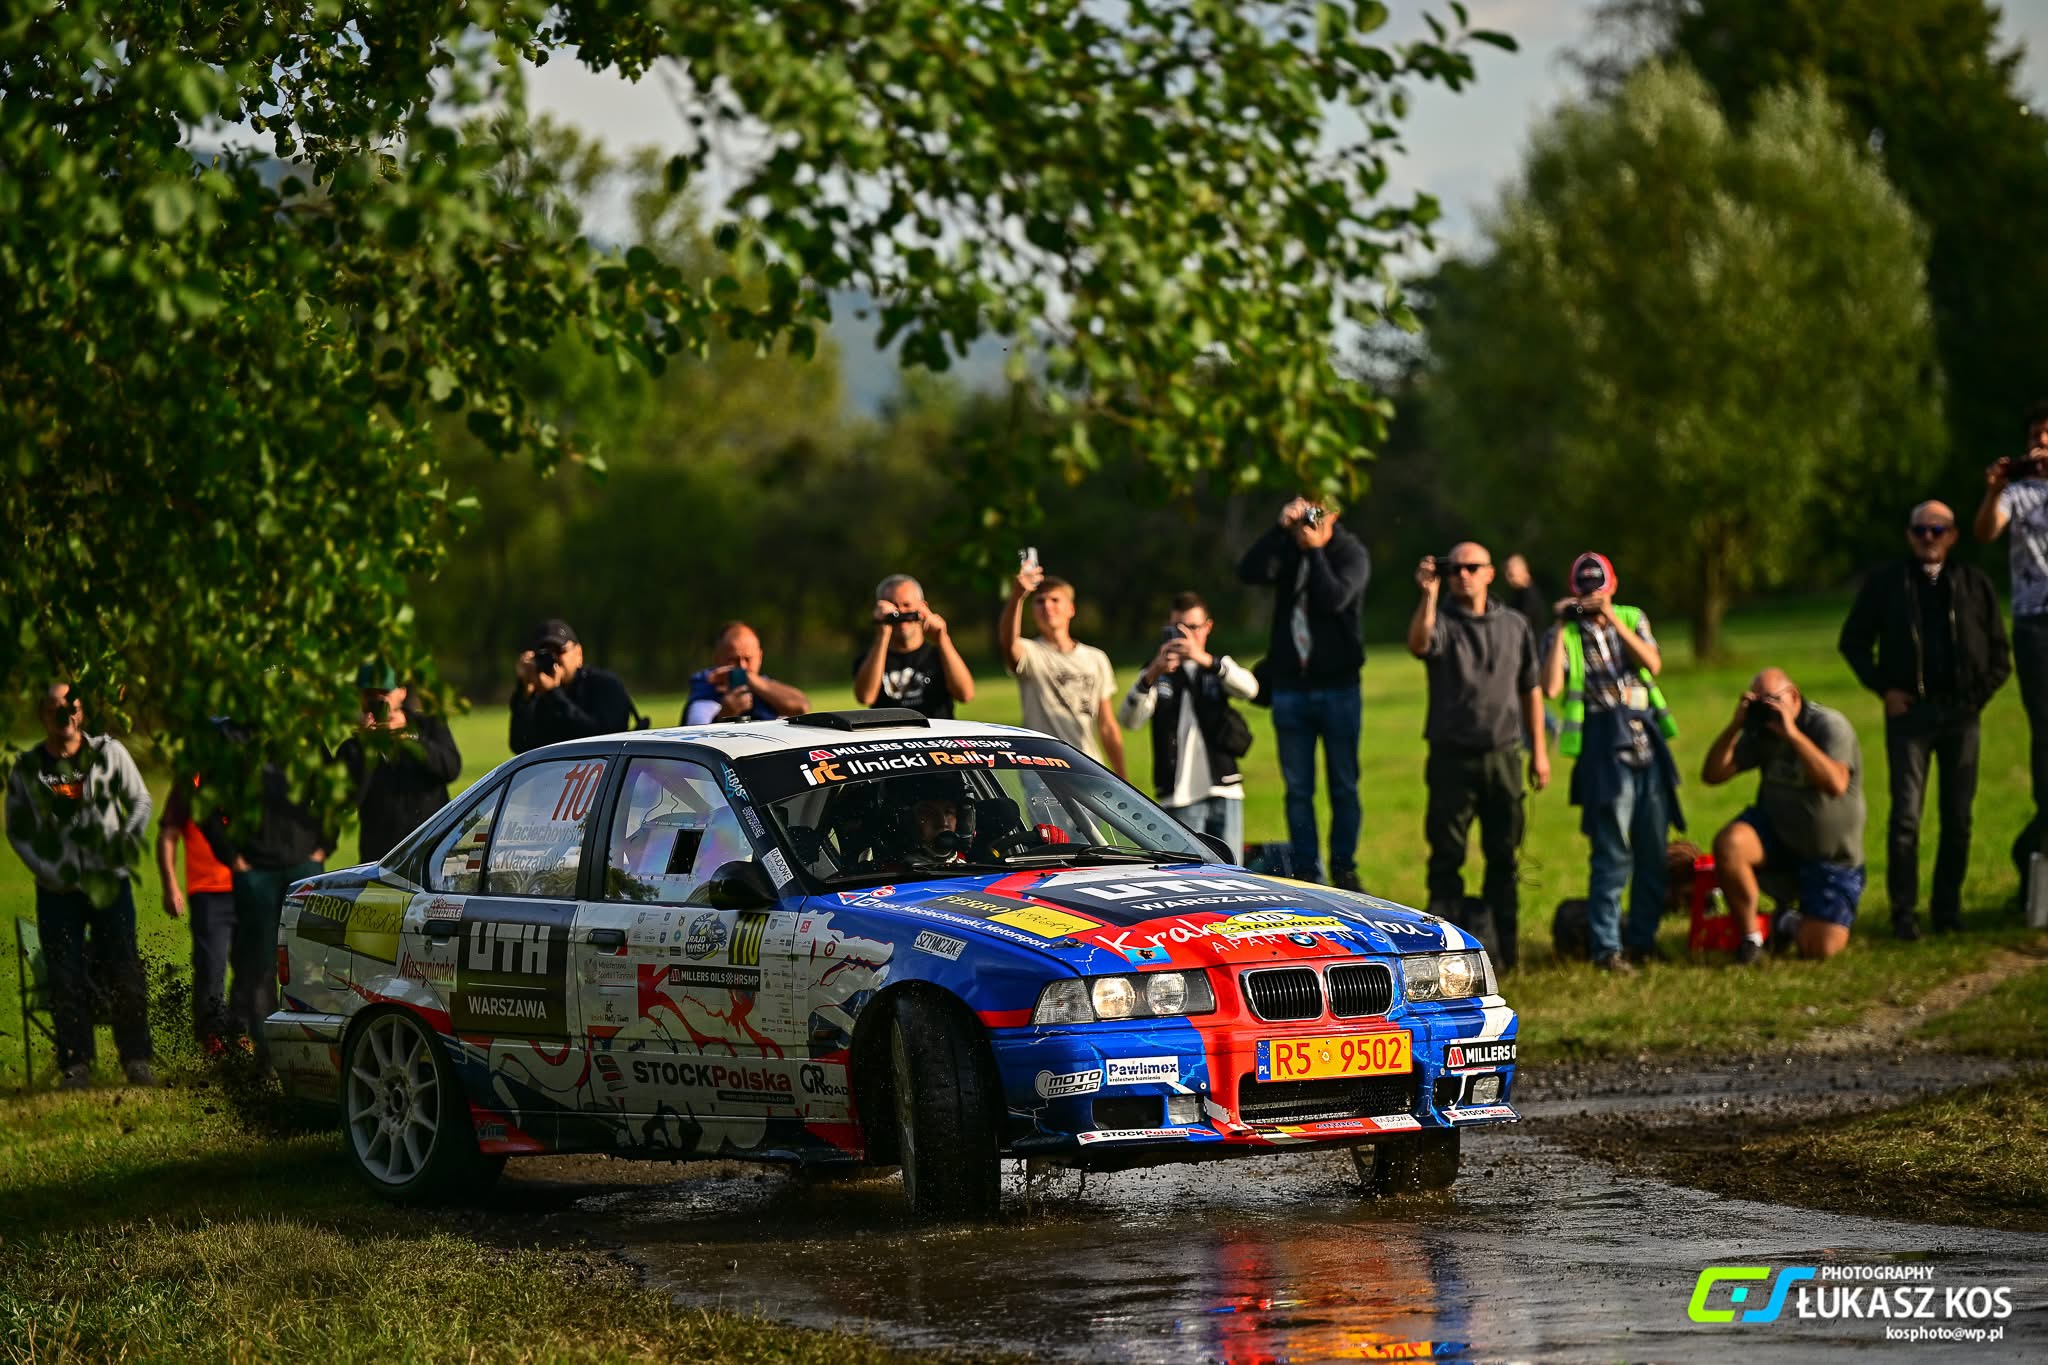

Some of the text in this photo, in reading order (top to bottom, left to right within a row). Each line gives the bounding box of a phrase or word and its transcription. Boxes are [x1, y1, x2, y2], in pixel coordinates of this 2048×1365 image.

[832, 739, 1012, 757] MILLERS OILS HRSMP
[849, 753, 928, 775] Ilnicki
[928, 751, 996, 768] Rally
[998, 751, 1072, 769] Team
[552, 763, 605, 822] 110
[1074, 878, 1271, 900] UTH
[303, 893, 351, 923] FERRO
[935, 894, 1013, 914] FERRO
[1134, 895, 1304, 912] WARSZAWA
[1246, 914, 1284, 923] 110
[469, 921, 551, 975] UTH
[688, 935, 706, 943] RAJD
[732, 914, 767, 966] 110
[916, 932, 961, 955] SZYMCZAK
[1211, 928, 1388, 953] APARENTS
[681, 971, 759, 986] MILLERS OILS HRSMP
[467, 995, 547, 1019] WARSZAWA
[1275, 1037, 1403, 1077] R5 9502
[1465, 1044, 1511, 1064] MILLERS
[632, 1060, 793, 1092] STOCKPolska
[1049, 1071, 1101, 1087] MOTO
[1108, 1061, 1178, 1077] Pawlimex
[1258, 1065, 1270, 1075] PL
[1048, 1082, 1099, 1096] WIZJA
[1101, 1129, 1187, 1138] STOCKPolska
